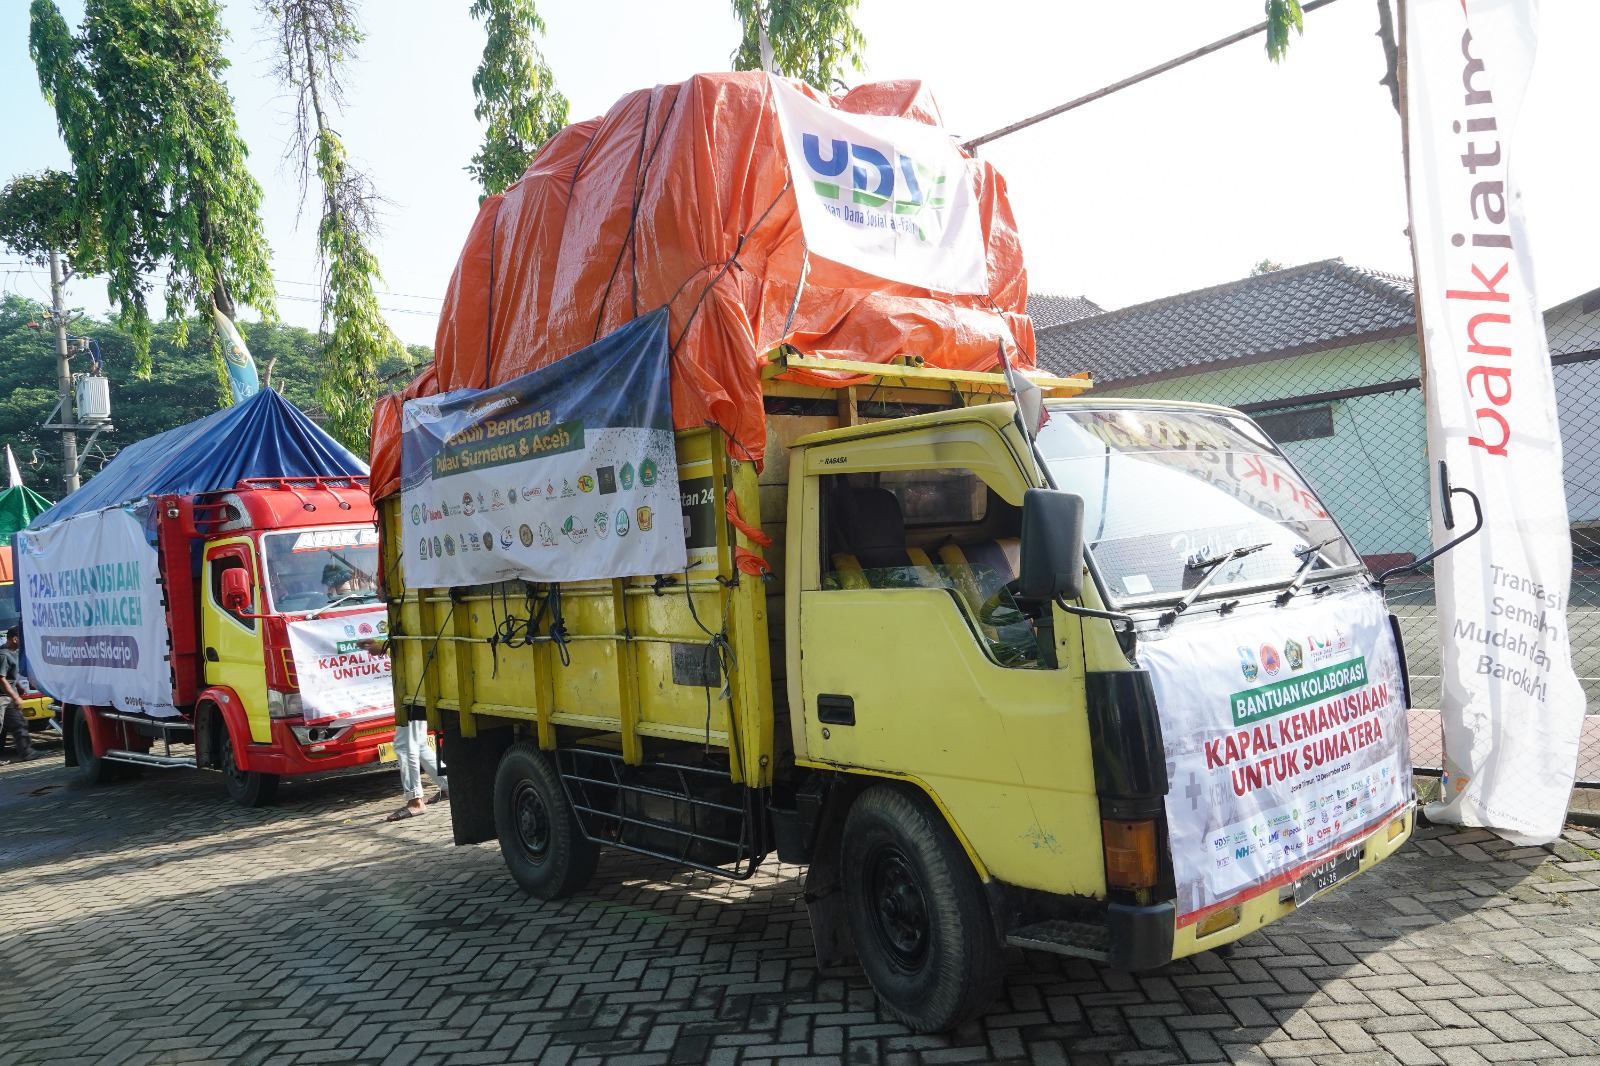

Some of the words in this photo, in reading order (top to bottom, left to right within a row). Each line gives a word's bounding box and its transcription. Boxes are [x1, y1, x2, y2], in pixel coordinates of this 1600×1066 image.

[844, 205, 864, 224] Dana
[485, 410, 551, 439] Bencana
[436, 455, 460, 473] Pulau
[461, 443, 517, 467] Sumatra
[519, 437, 530, 456] &
[532, 428, 570, 451] Aceh
[681, 492, 699, 507] tan
[111, 596, 143, 627] ACEH
[1453, 618, 1528, 657] Mudah
[318, 653, 366, 670] KAPAL
[333, 662, 381, 680] UNTUK
[1476, 654, 1547, 703] Barokah!
[1236, 683, 1300, 719] BANTUAN
[1300, 662, 1365, 700] KOLABORASI
[1203, 724, 1278, 770] KAPAL
[1279, 682, 1389, 750] KEMANUSIAAN
[1231, 748, 1301, 797] UNTUK
[1303, 716, 1383, 771] SUMATERA
